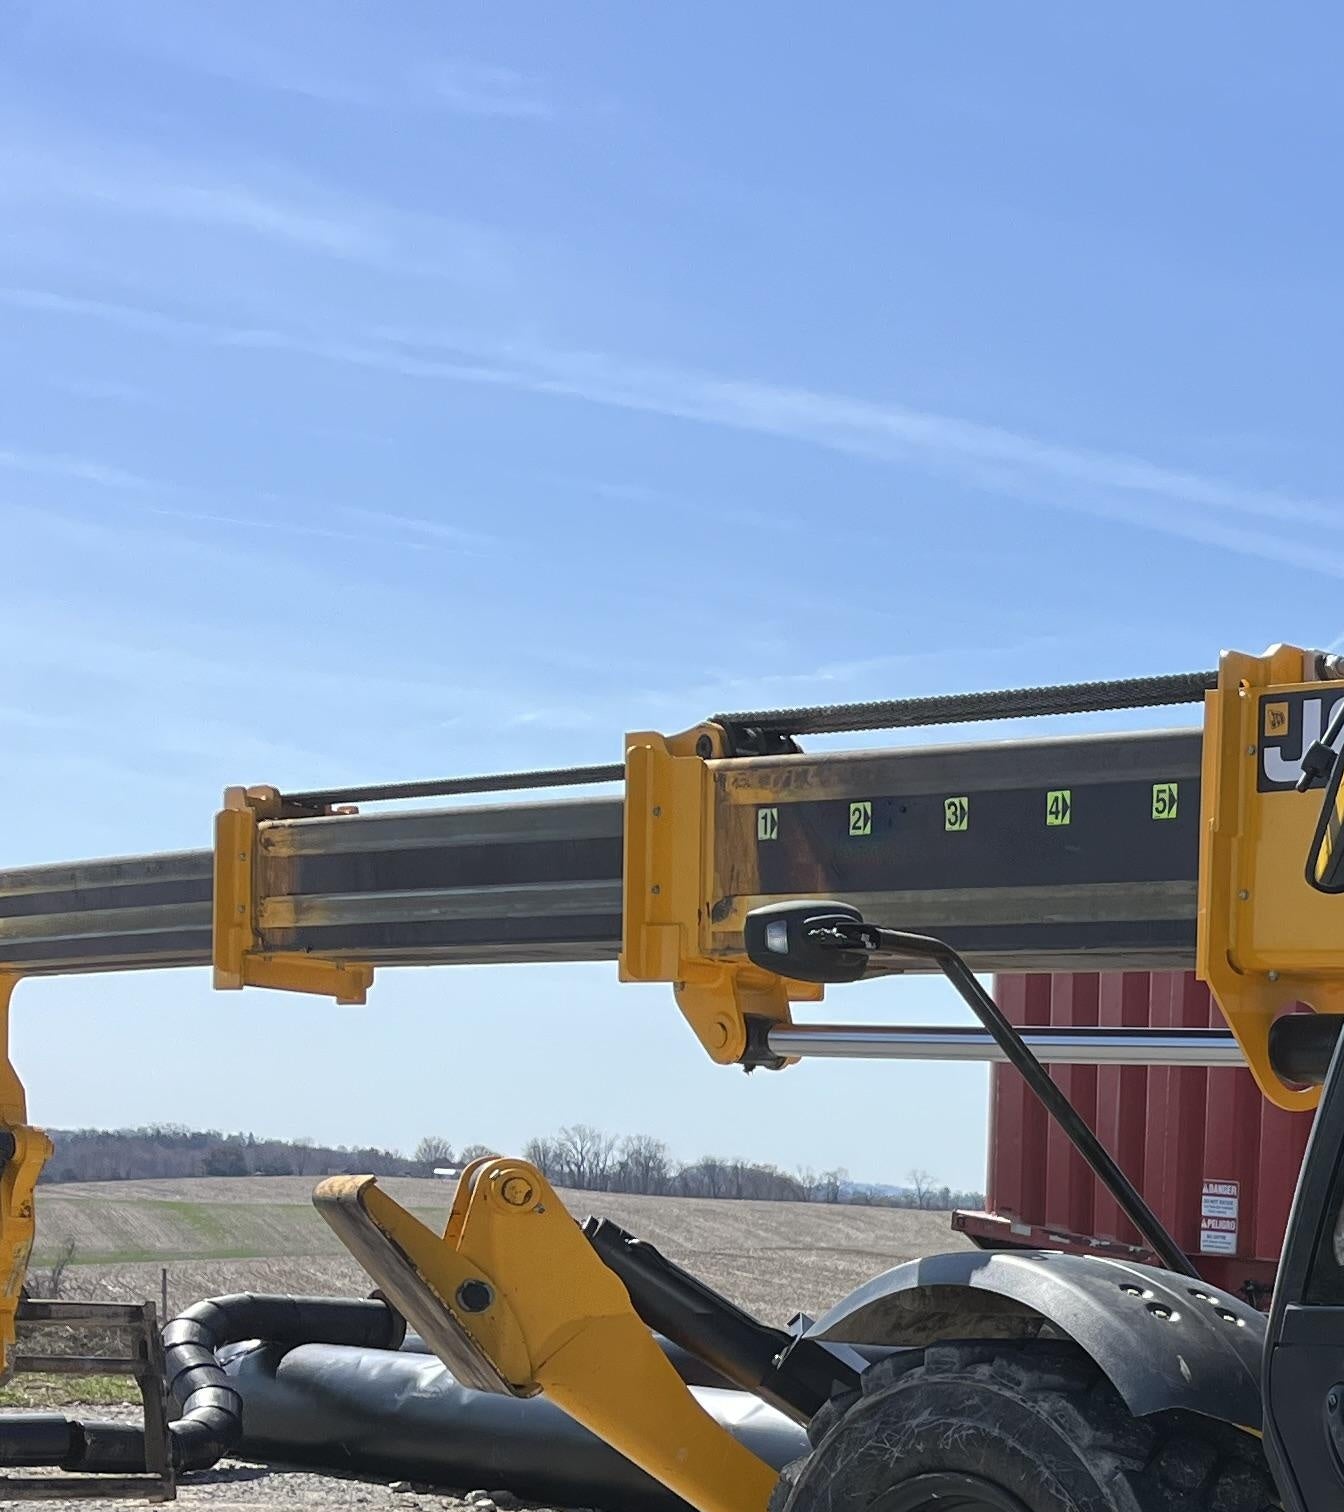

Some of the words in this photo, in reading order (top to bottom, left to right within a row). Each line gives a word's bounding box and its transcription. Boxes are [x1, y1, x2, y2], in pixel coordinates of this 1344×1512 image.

[946, 802, 958, 826] 3
[1049, 796, 1060, 820] 4
[1155, 789, 1167, 815] 5
[761, 812, 768, 835] 1
[851, 807, 862, 831] 2
